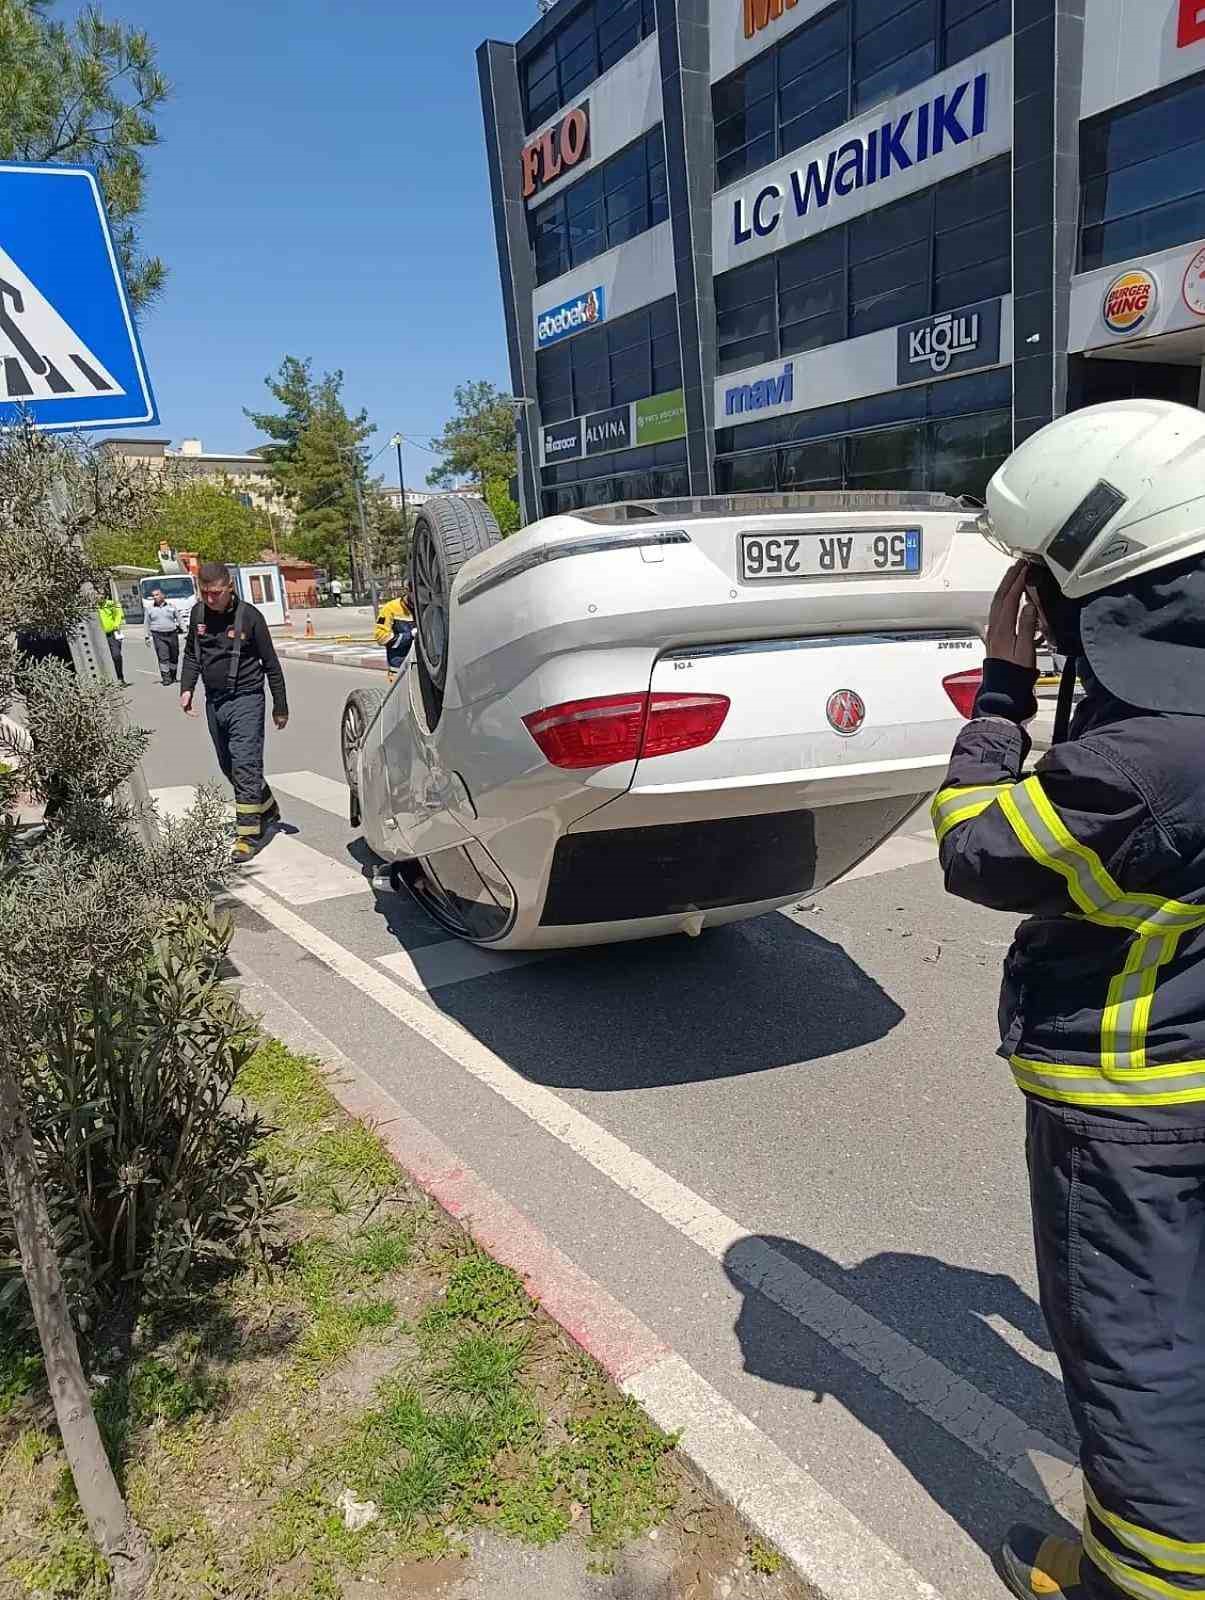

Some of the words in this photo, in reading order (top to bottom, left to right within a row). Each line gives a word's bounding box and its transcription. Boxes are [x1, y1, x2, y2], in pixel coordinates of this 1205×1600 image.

[521, 109, 587, 196] FLO
[733, 185, 781, 245] LC
[1106, 295, 1149, 318] KING
[1109, 284, 1151, 303] BURGER
[725, 362, 794, 416] mavi
[586, 419, 626, 443] ALVINA
[746, 539, 801, 574] 256
[818, 536, 854, 570] AR
[873, 535, 905, 568] 56
[937, 641, 973, 650] PASSAT
